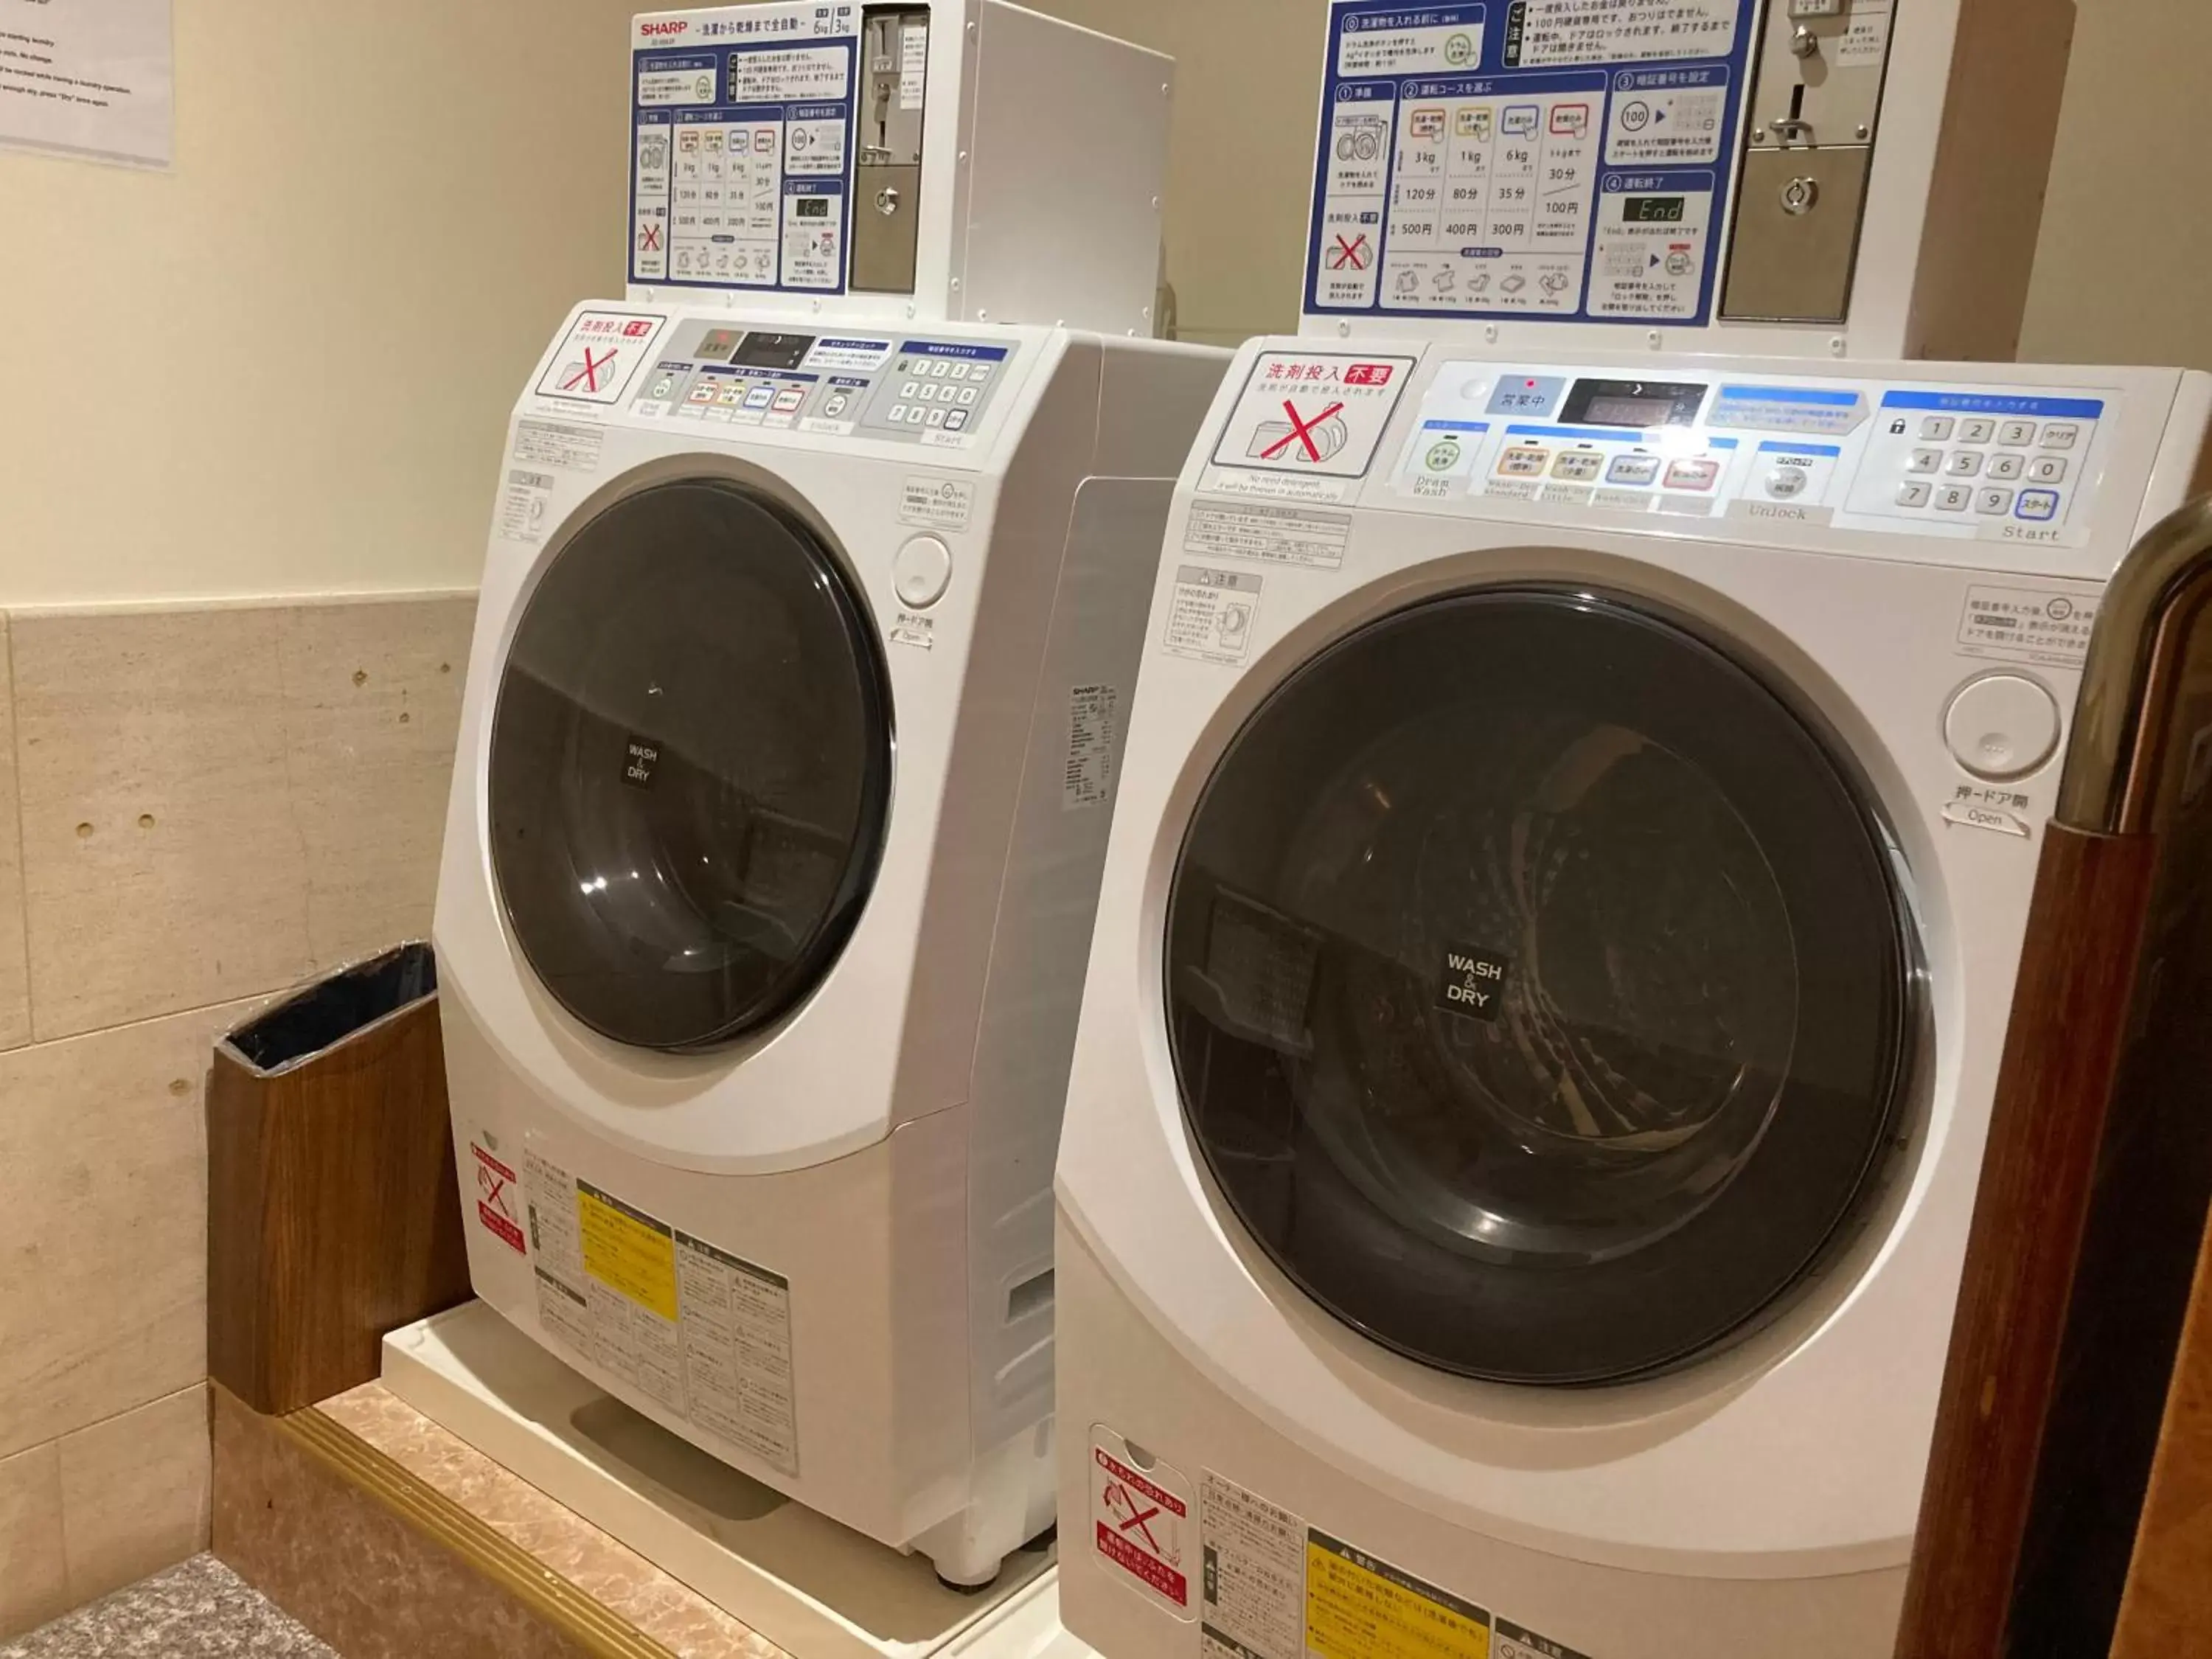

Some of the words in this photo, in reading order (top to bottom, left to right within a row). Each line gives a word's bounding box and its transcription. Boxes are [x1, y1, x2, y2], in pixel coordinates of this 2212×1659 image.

[641, 21, 688, 36] SHARP
[1636, 71, 1710, 86] 暗証番号を設定
[1421, 81, 1493, 96] 運転コースを選ぶ
[1624, 110, 1646, 122] 100
[1415, 150, 1436, 164] 3kg
[1461, 150, 1481, 164] 1kg
[1506, 149, 1528, 163] 6kg
[1406, 188, 1436, 200] 120分
[1453, 188, 1478, 200] 80分
[1498, 188, 1525, 200] 35分
[1548, 168, 1576, 180] 30分
[1624, 178, 1663, 189] 運転終了
[1545, 202, 1579, 215] 100円
[1639, 200, 1683, 220] End
[1402, 223, 1432, 235] 500円
[1446, 223, 1477, 236] 400円
[1492, 223, 1524, 235] 300円
[1265, 364, 1340, 381] 洗剤投入
[1348, 365, 1391, 385] 不要
[1500, 394, 1545, 408] 営業中
[1933, 422, 1941, 434] 1
[1970, 425, 1982, 438] 2
[2011, 426, 2023, 439] 3
[1919, 454, 1930, 467] 4
[1959, 456, 1971, 470] 5
[2000, 459, 2012, 473] 6
[2041, 462, 2054, 476] 0
[1413, 486, 1447, 497] Wash
[1909, 487, 1921, 501] 7
[1947, 490, 1959, 504] 8
[1988, 494, 2000, 507] 9
[2022, 498, 2052, 511] スタート
[1749, 504, 1806, 520] Unlock
[2003, 525, 2060, 543] Start
[629, 743, 657, 762] WASH
[627, 766, 650, 782] DRY
[1968, 809, 2003, 825] Open
[1447, 953, 1502, 981] WASH
[1464, 973, 1476, 990] &
[1447, 984, 1490, 1008] DRY
